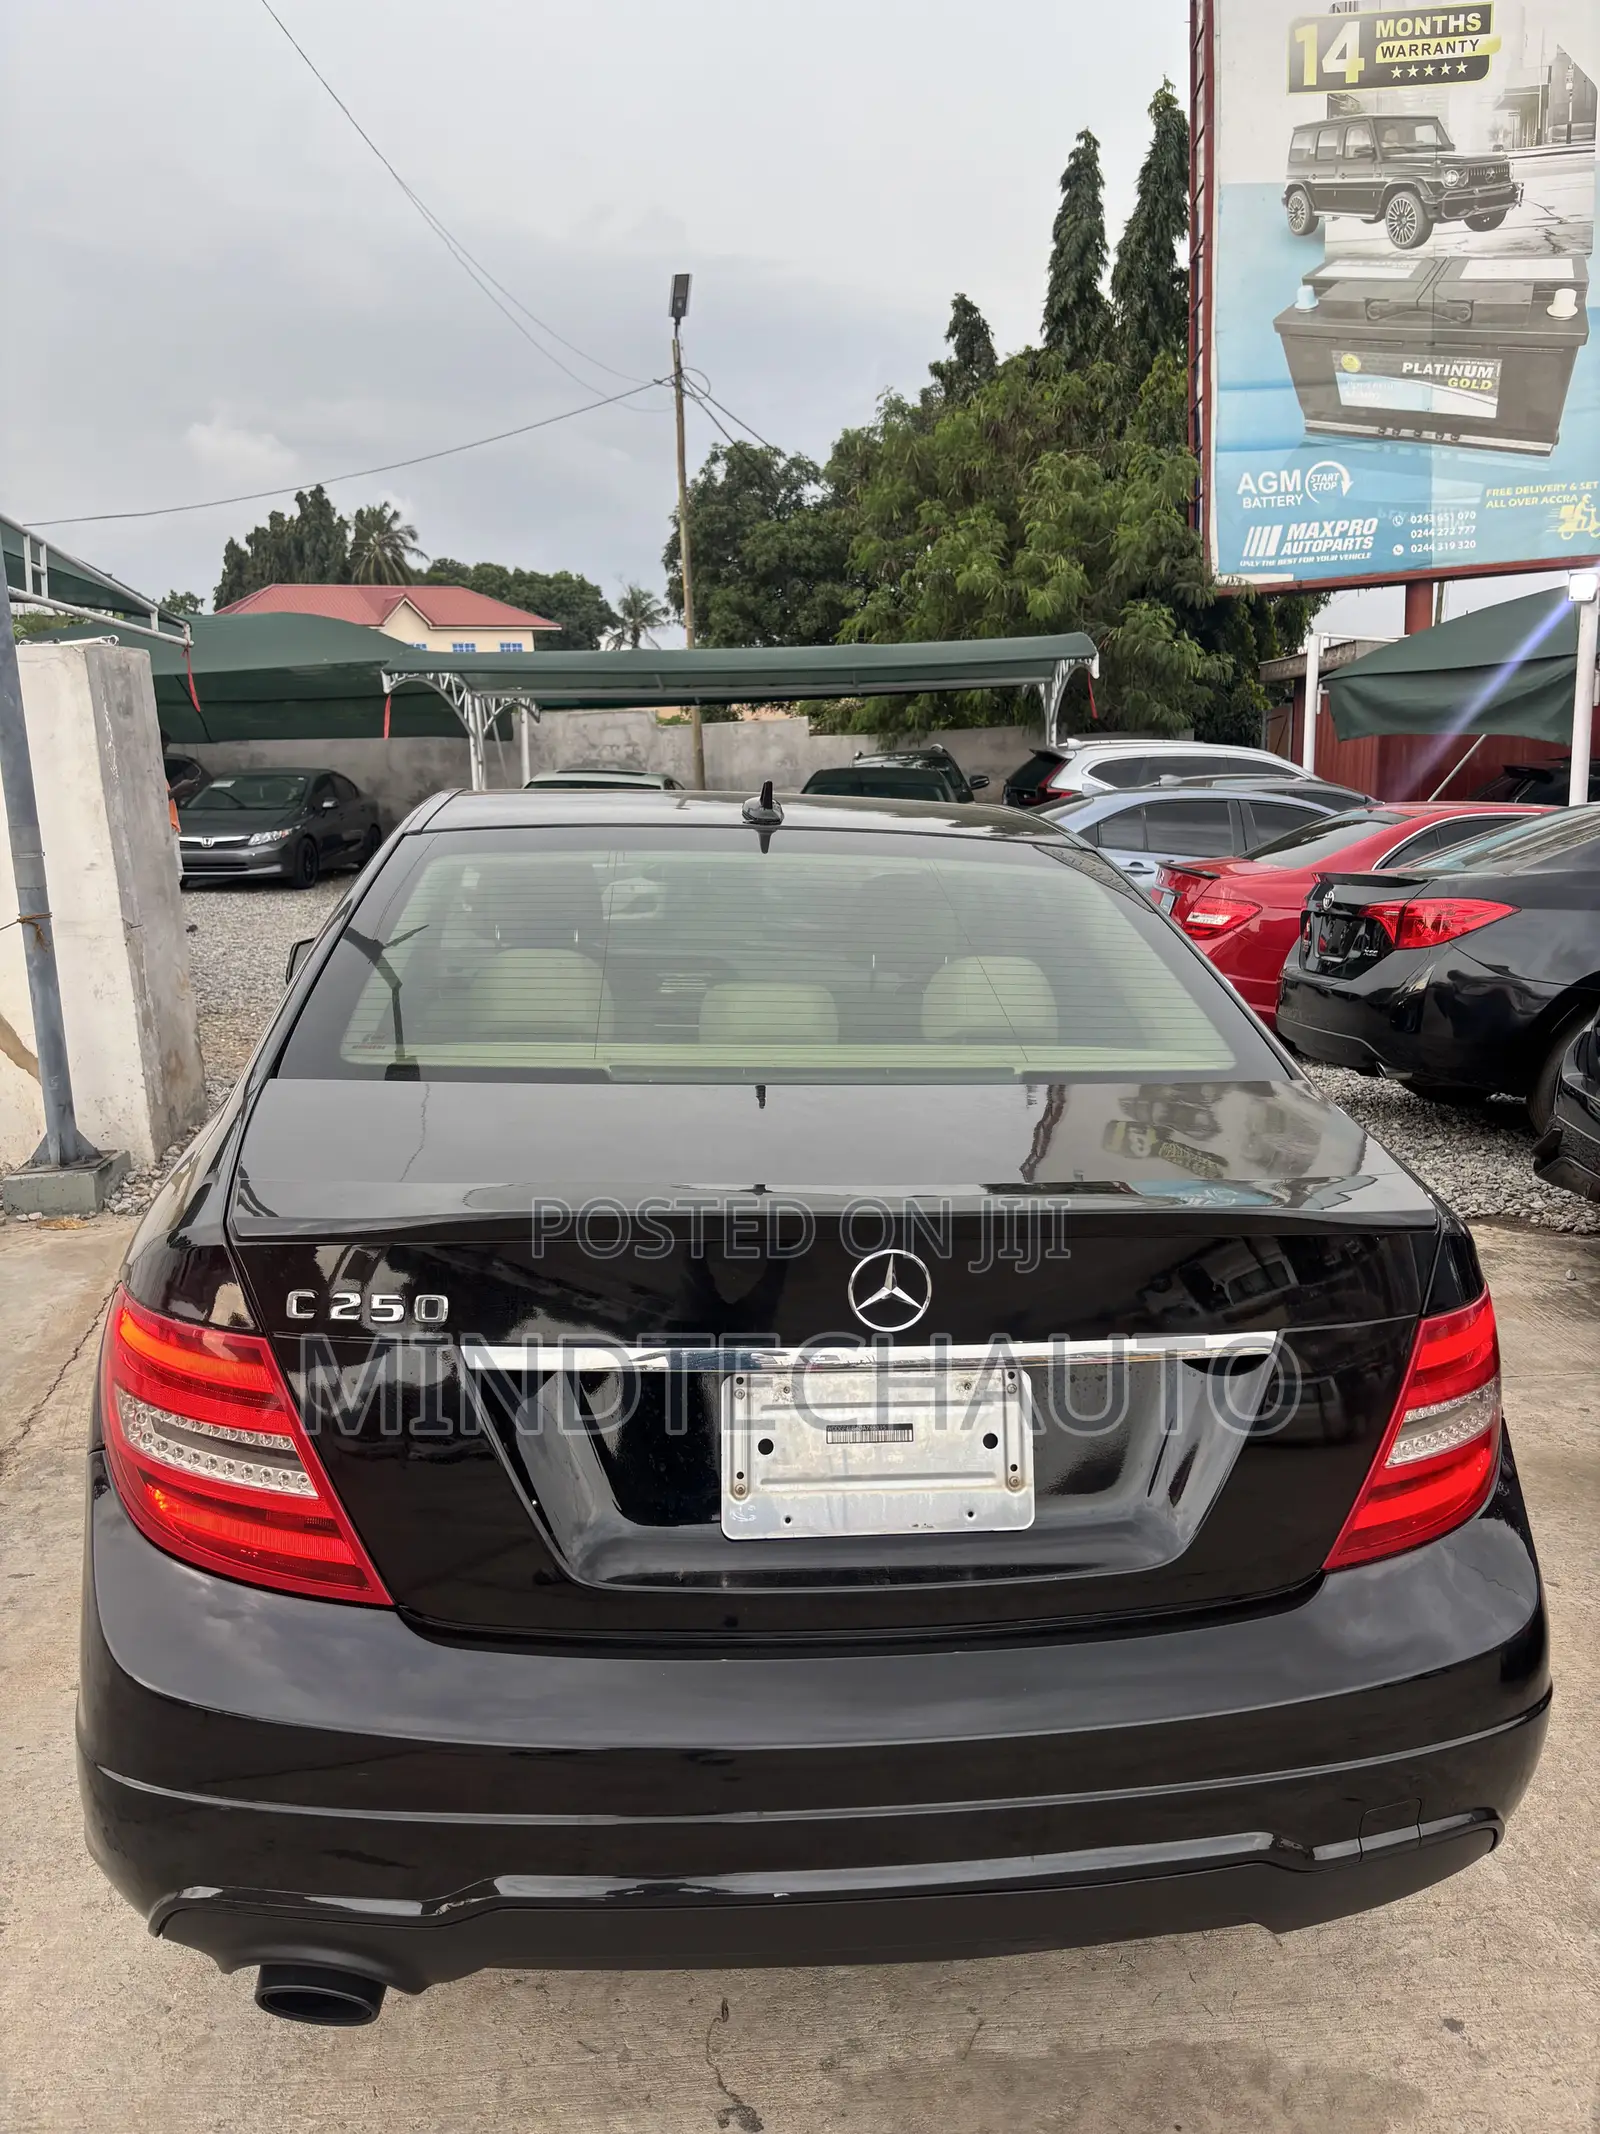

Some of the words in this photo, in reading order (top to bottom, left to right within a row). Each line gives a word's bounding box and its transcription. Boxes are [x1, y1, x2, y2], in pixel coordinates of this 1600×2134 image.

[1376, 12, 1482, 39] MONTHS
[1295, 21, 1365, 86] 14
[1381, 39, 1480, 59] WARRANTY
[1402, 361, 1495, 379] PLATINUM
[1447, 378, 1493, 391] GOLD
[1237, 469, 1301, 495] AGM
[1310, 472, 1340, 483] START
[1312, 482, 1338, 492] STOP
[1486, 487, 1513, 498] FREE
[1515, 483, 1567, 495] DELIVERY
[1569, 482, 1577, 491] &
[1242, 494, 1304, 509] BATTERY
[1485, 499, 1507, 509] ALL
[1508, 497, 1538, 507] OVER
[1540, 494, 1577, 505] ACCRA
[1457, 511, 1476, 521] 070
[1286, 517, 1379, 541] MAXPRO
[1410, 528, 1435, 539] 0244
[1437, 526, 1456, 537] 272
[1457, 525, 1476, 535] 777
[1280, 536, 1374, 556] AUTOPARTS
[1410, 542, 1435, 553] 0244
[1437, 541, 1456, 551] 319
[1457, 540, 1476, 550] 320
[1239, 558, 1261, 568] ONLY
[1262, 558, 1276, 567] THE
[1277, 557, 1297, 566] BEST
[1298, 555, 1315, 565] FOR
[1316, 554, 1338, 563] YOUR
[1339, 552, 1372, 560] VEHICLE
[286, 1289, 318, 1319] C
[330, 1291, 450, 1323] 250
